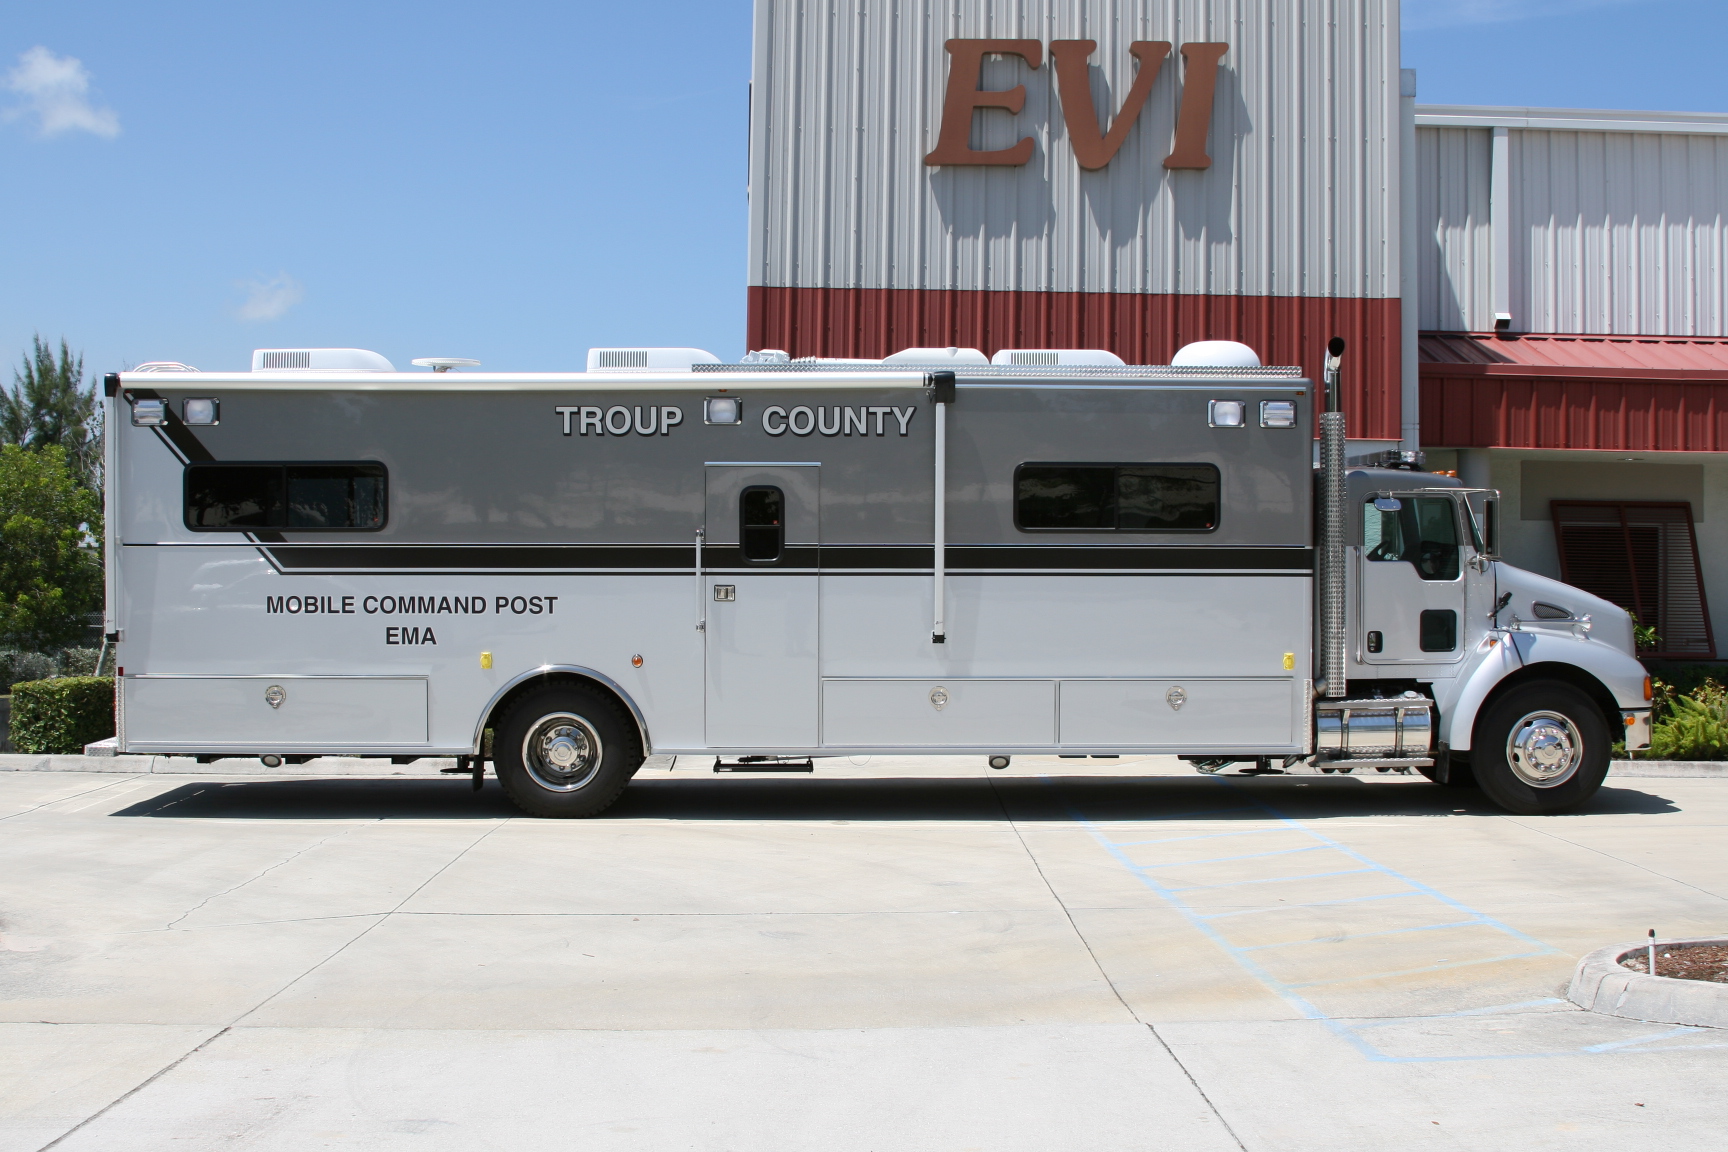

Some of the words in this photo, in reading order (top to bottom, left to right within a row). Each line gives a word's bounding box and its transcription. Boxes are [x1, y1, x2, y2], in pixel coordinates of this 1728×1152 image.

[924, 39, 1229, 170] EVI
[555, 405, 684, 437] TROUP
[762, 405, 916, 437] COUNTY
[266, 595, 355, 614] MOBILE
[363, 595, 487, 614] COMMAND
[495, 595, 558, 614] POST
[385, 627, 437, 645] EMA
